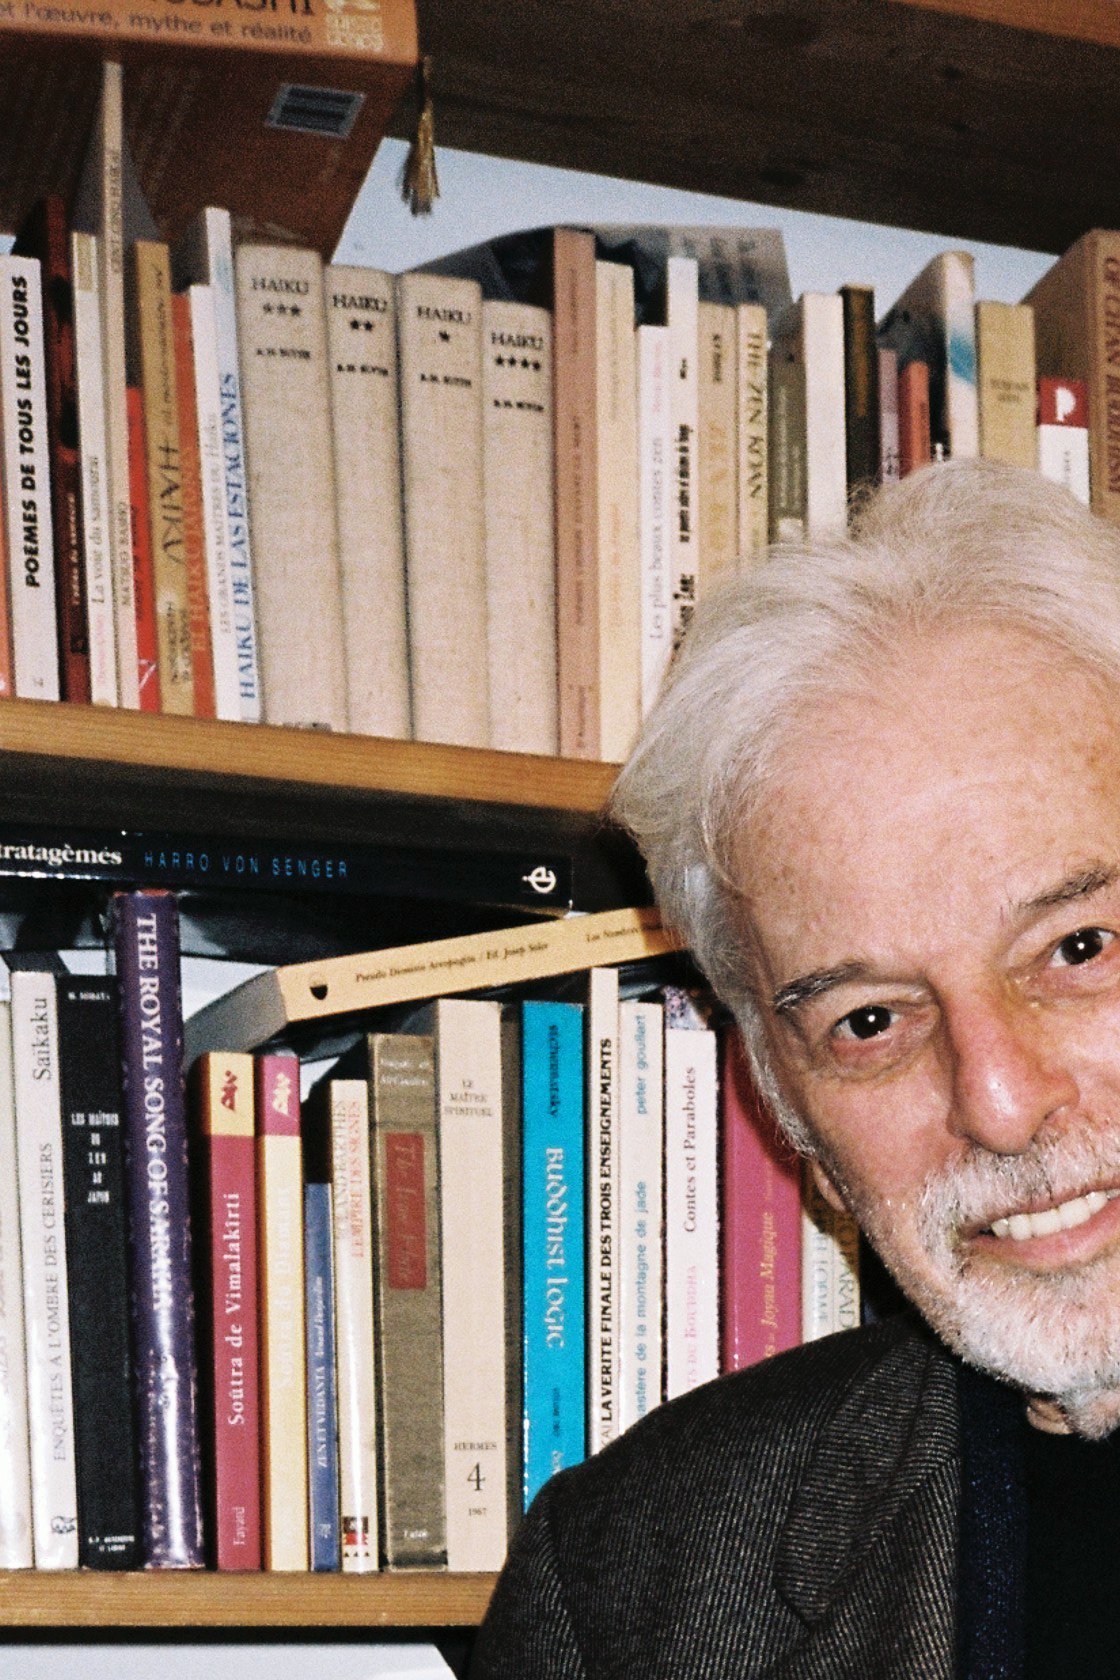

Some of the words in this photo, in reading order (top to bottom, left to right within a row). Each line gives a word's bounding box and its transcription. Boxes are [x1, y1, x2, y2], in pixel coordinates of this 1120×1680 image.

[130, 12, 202, 37] mythe
[210, 19, 232, 37] et
[241, 22, 312, 44] réalité
[250, 276, 309, 294] HAIKU
[332, 294, 388, 313] HAIKU
[11, 275, 30, 347] JOURS
[417, 305, 471, 324] HAIKU
[491, 332, 545, 351] HAIKU
[15, 354, 32, 390] LES
[17, 399, 34, 455] TOUS
[219, 372, 245, 517] ESTACIONES
[19, 464, 36, 491] DE
[230, 521, 247, 568] LAS
[233, 577, 250, 607] DE
[235, 617, 256, 698] HAIKU
[144, 851, 210, 872] HARRO
[222, 855, 260, 874] VON
[272, 857, 348, 879] SENGER
[135, 913, 159, 970] THE
[138, 975, 163, 1070] ROYAL
[599, 1037, 612, 1179] ENSEIGNEMENTS
[635, 1076, 649, 1115] peter
[681, 1066, 697, 1150] Paraboles
[143, 1077, 168, 1154] SONG
[147, 1158, 169, 1197] OF
[683, 1156, 697, 1171] et
[39, 1142, 56, 1229] CERISIERS
[634, 1181, 650, 1214] jade
[683, 1175, 697, 1233] Contes
[599, 1181, 612, 1231] TROIS
[635, 1219, 648, 1239] de
[42, 1235, 59, 1267] DES
[599, 1234, 612, 1268] DES
[634, 1244, 651, 1318] montagne
[43, 1274, 60, 1348] L'OMBRE
[600, 1271, 612, 1333] FINALE
[224, 1323, 243, 1348] de
[635, 1324, 647, 1337] la
[635, 1343, 647, 1361] de
[224, 1356, 245, 1425] Soûtra
[46, 1372, 67, 1461] ENQUÊTES
[600, 1400, 613, 1422] LA
[466, 1461, 487, 1491] 4
